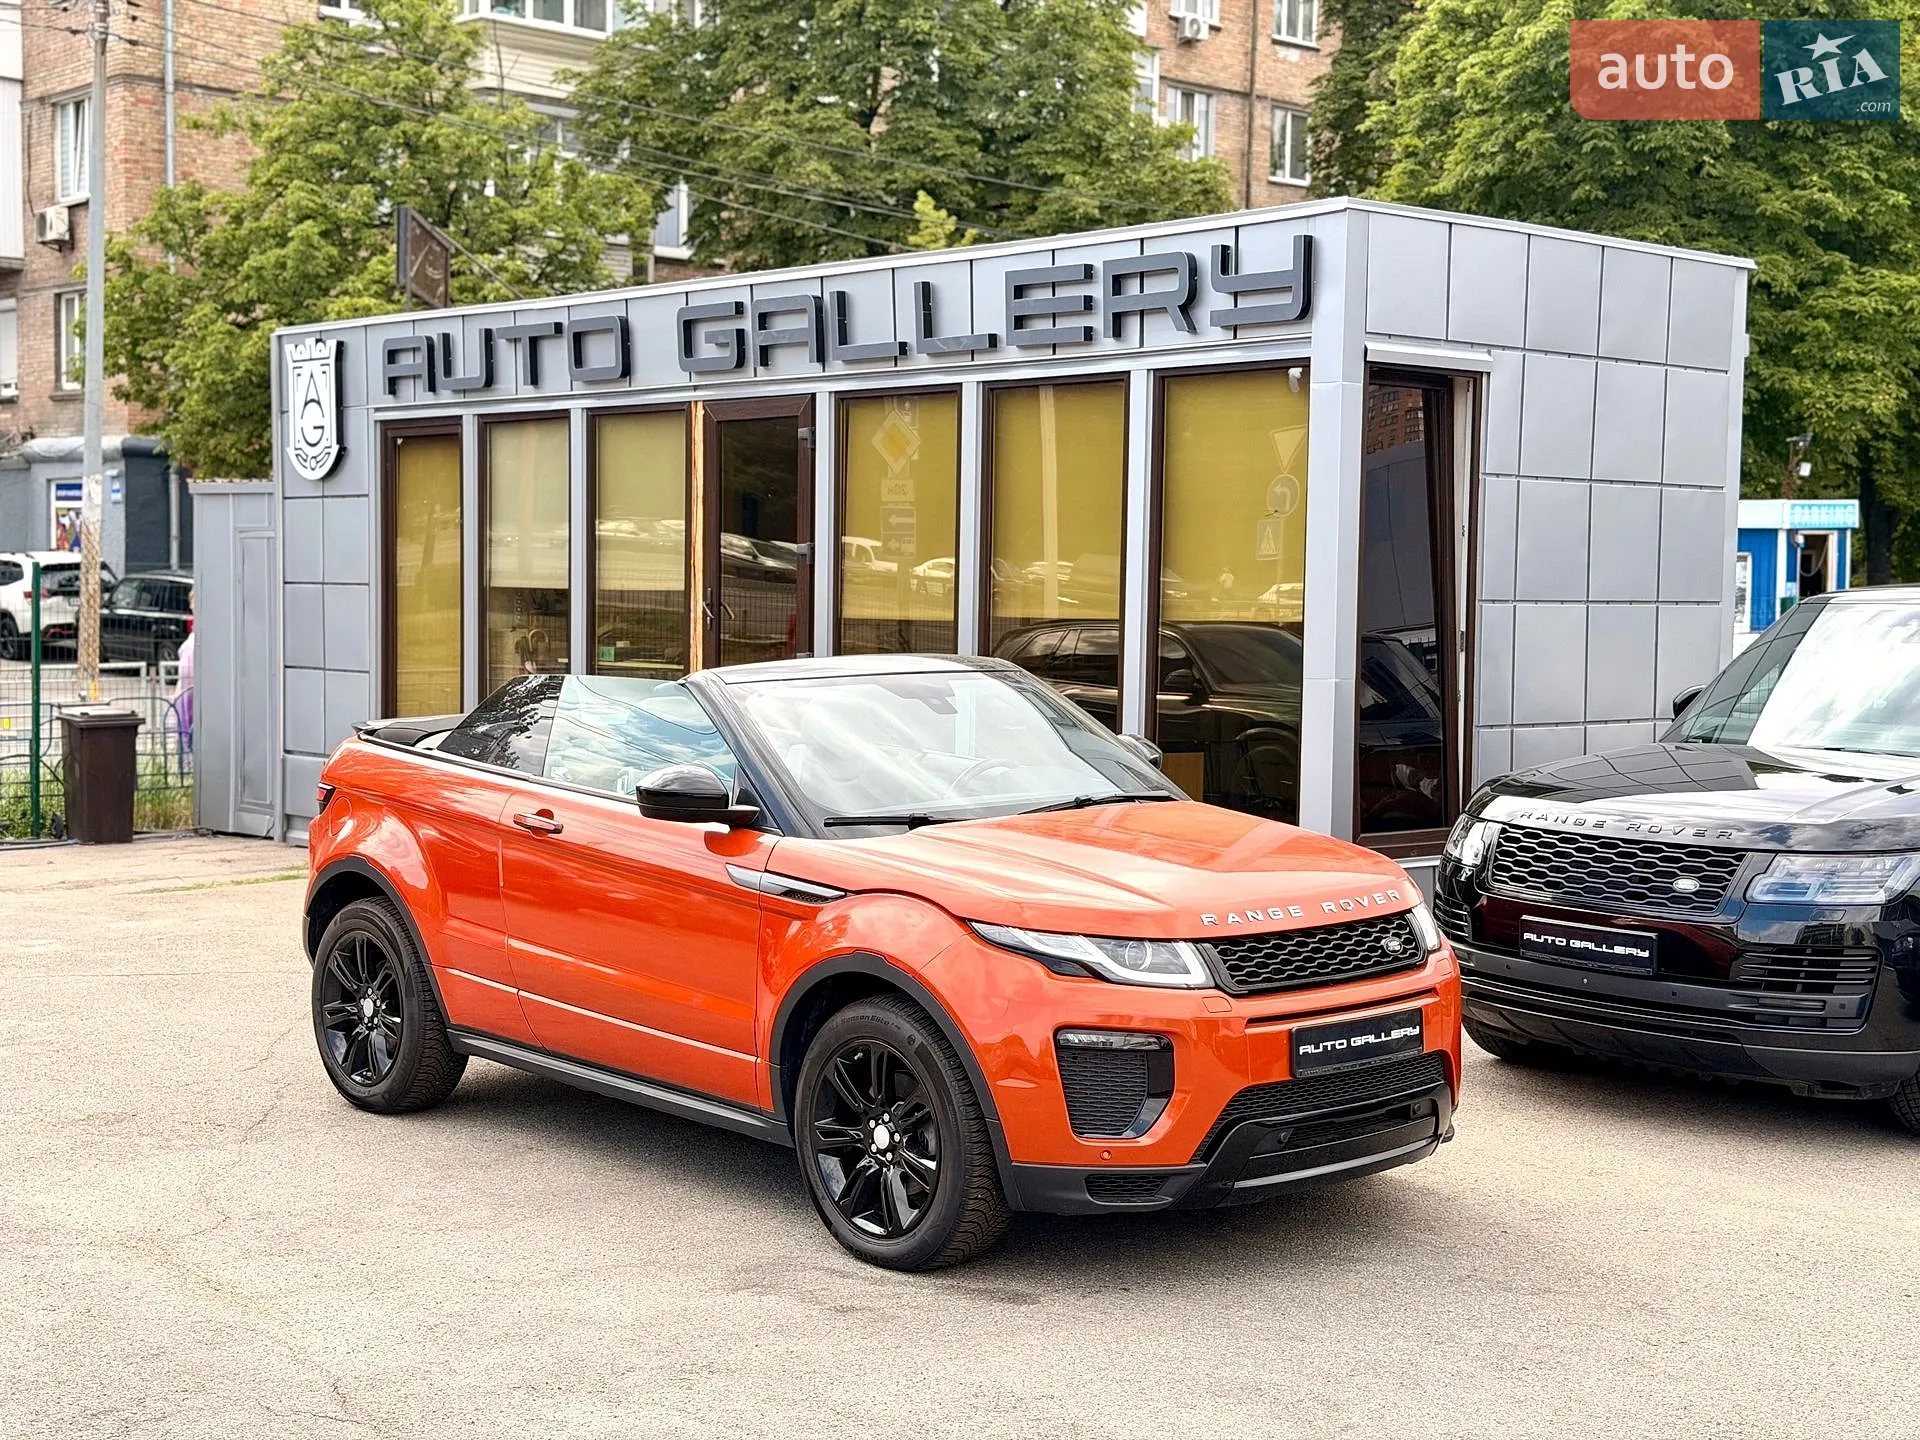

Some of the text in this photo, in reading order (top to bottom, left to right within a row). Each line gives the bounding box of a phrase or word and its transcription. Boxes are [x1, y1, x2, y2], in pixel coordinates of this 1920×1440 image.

[382, 234, 1316, 396] AUTO GALLERY
[1519, 811, 1734, 841] RANGE ROVER
[1200, 888, 1401, 926] RANGE ROVER
[1523, 932, 1650, 958] AUTO GALLERY
[1299, 1025, 1420, 1056] AUTO GALLERY
